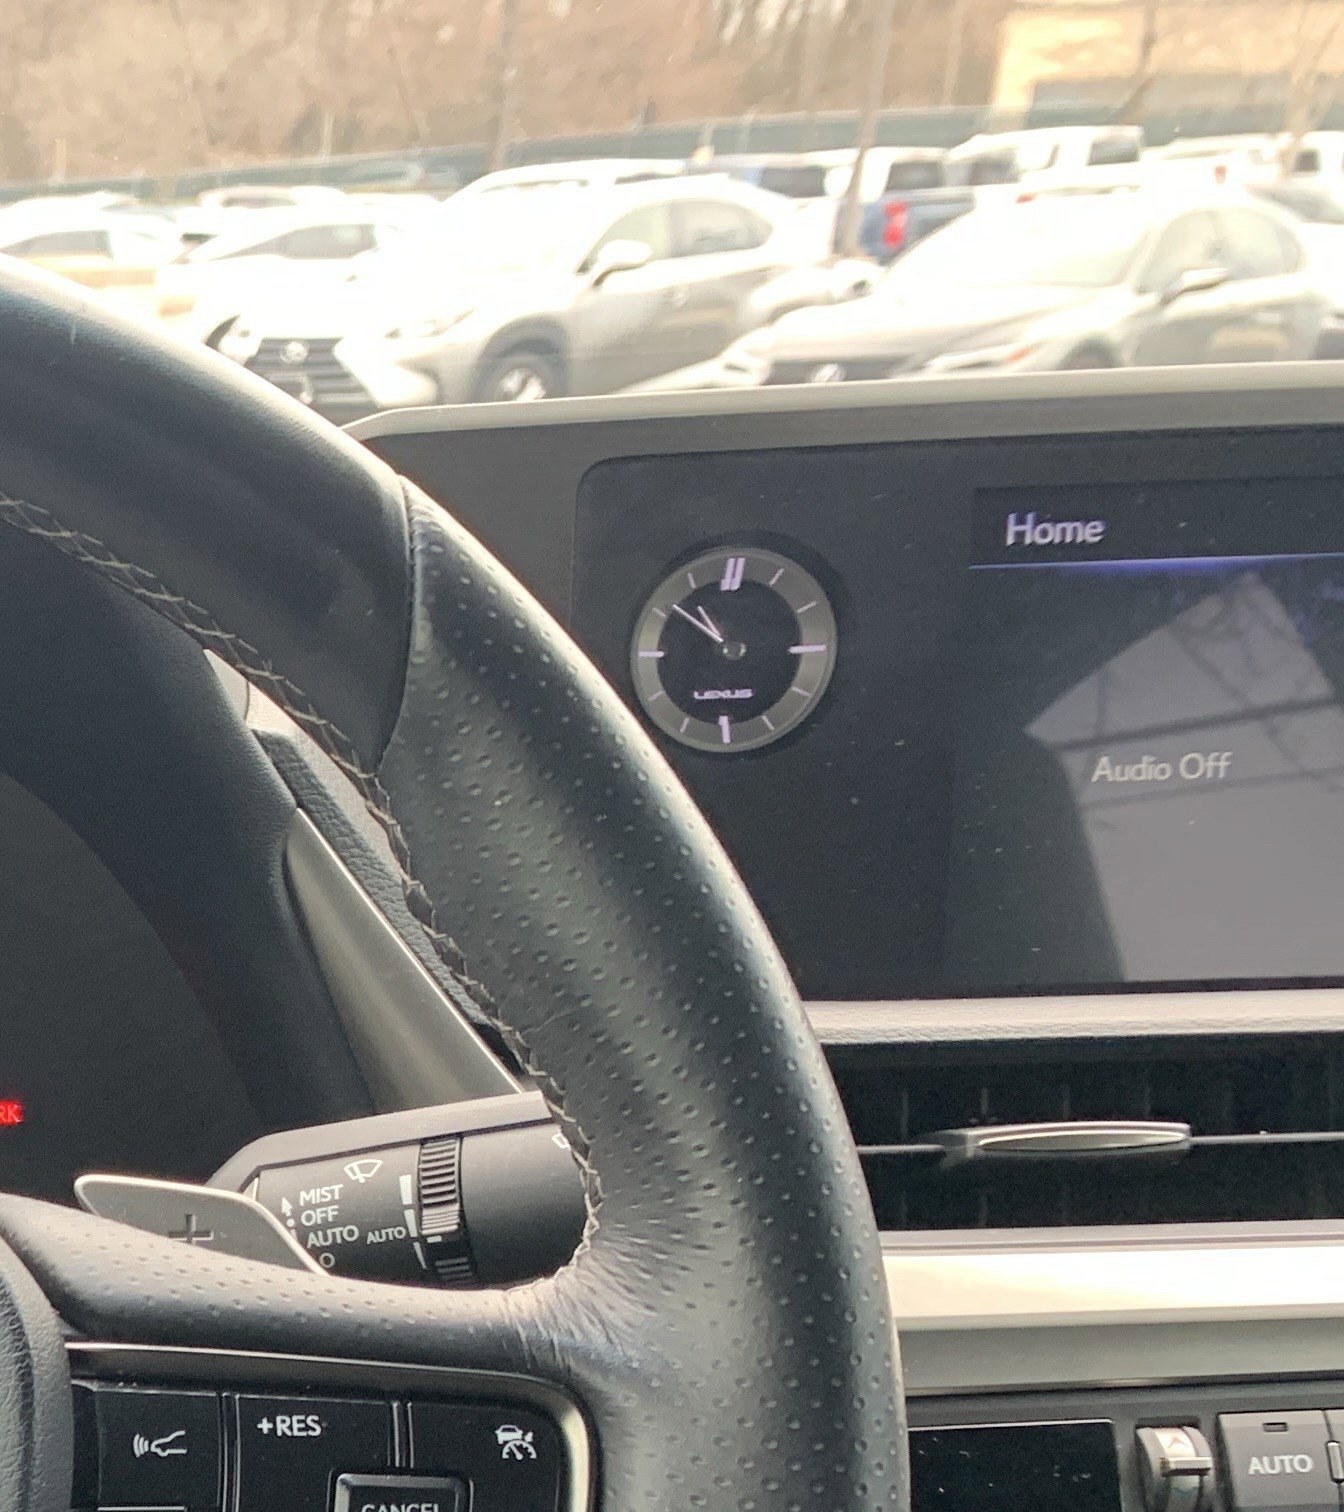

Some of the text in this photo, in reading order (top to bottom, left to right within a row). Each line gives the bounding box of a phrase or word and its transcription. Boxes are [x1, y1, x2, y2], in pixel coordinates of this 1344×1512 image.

[1007, 513, 1105, 545] Home
[694, 689, 753, 699] LEXUS
[1092, 752, 1232, 782] Audio Off
[299, 1184, 344, 1206] MIST
[300, 1205, 340, 1226] OFF
[307, 1225, 359, 1249] AUTO
[367, 1227, 406, 1244] AUTO
[257, 1415, 321, 1436] +RES
[1249, 1455, 1313, 1474] AUTO
